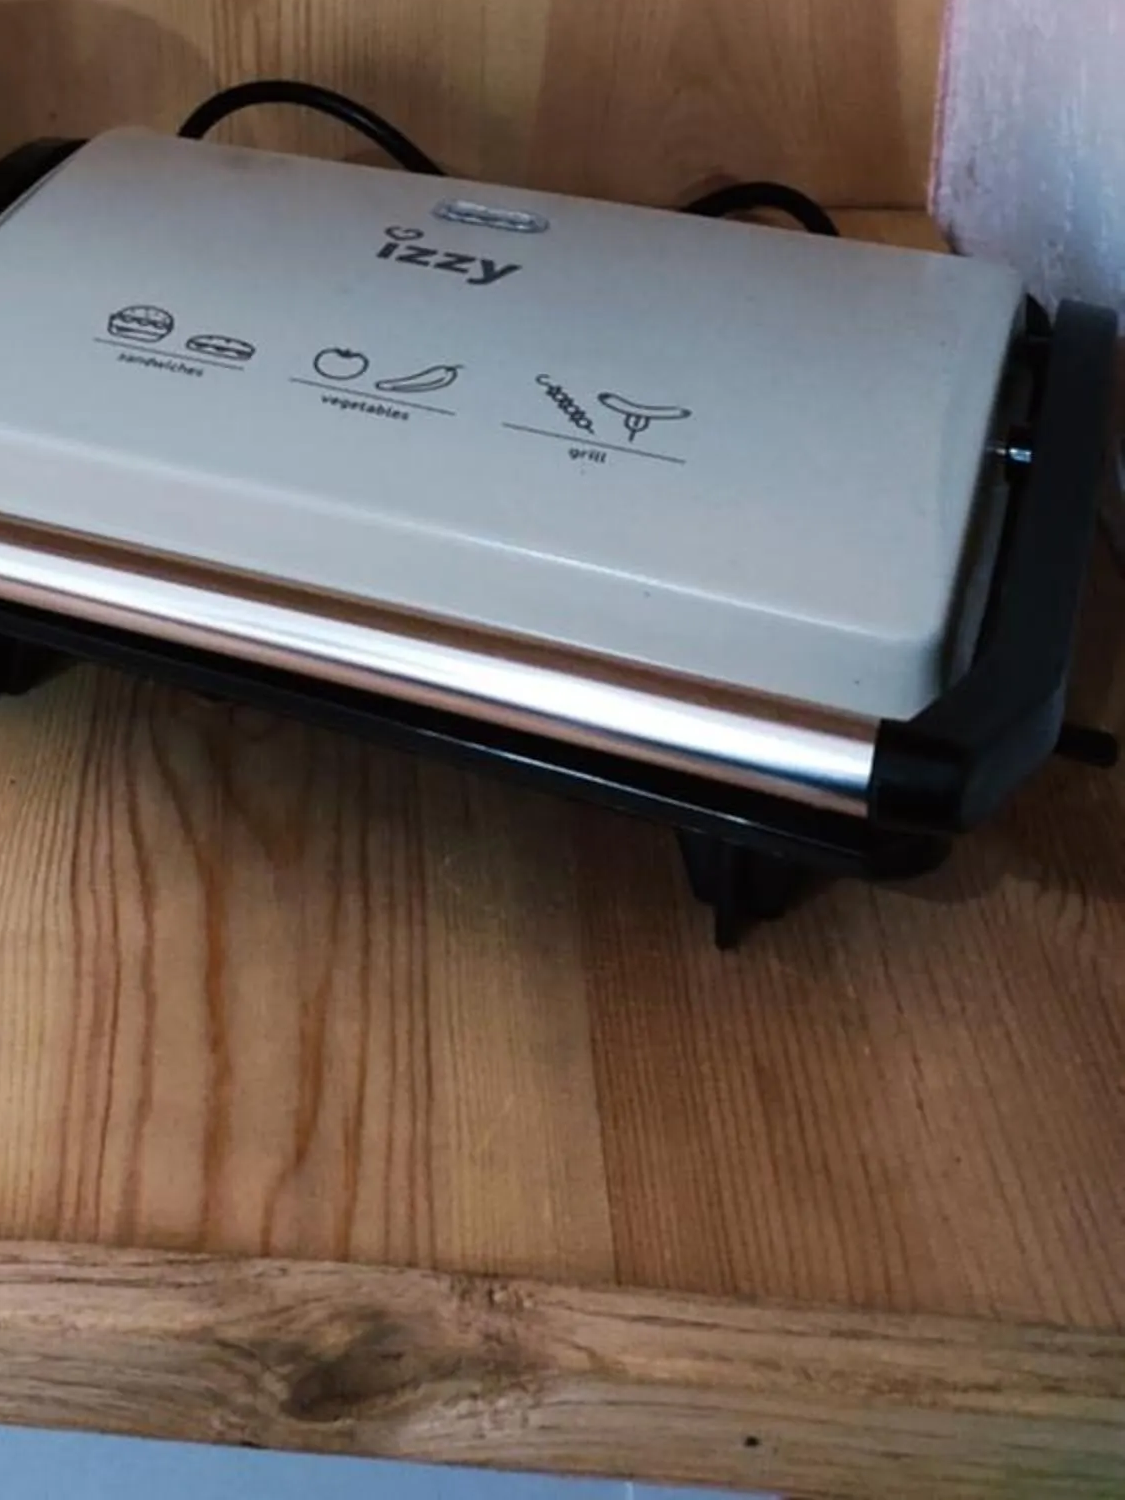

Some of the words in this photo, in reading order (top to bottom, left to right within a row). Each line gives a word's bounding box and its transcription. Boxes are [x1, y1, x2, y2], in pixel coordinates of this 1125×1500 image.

[376, 225, 521, 286] izzy
[117, 351, 204, 377] sandwiches
[321, 393, 410, 421] vegetables
[568, 448, 608, 464] grill
